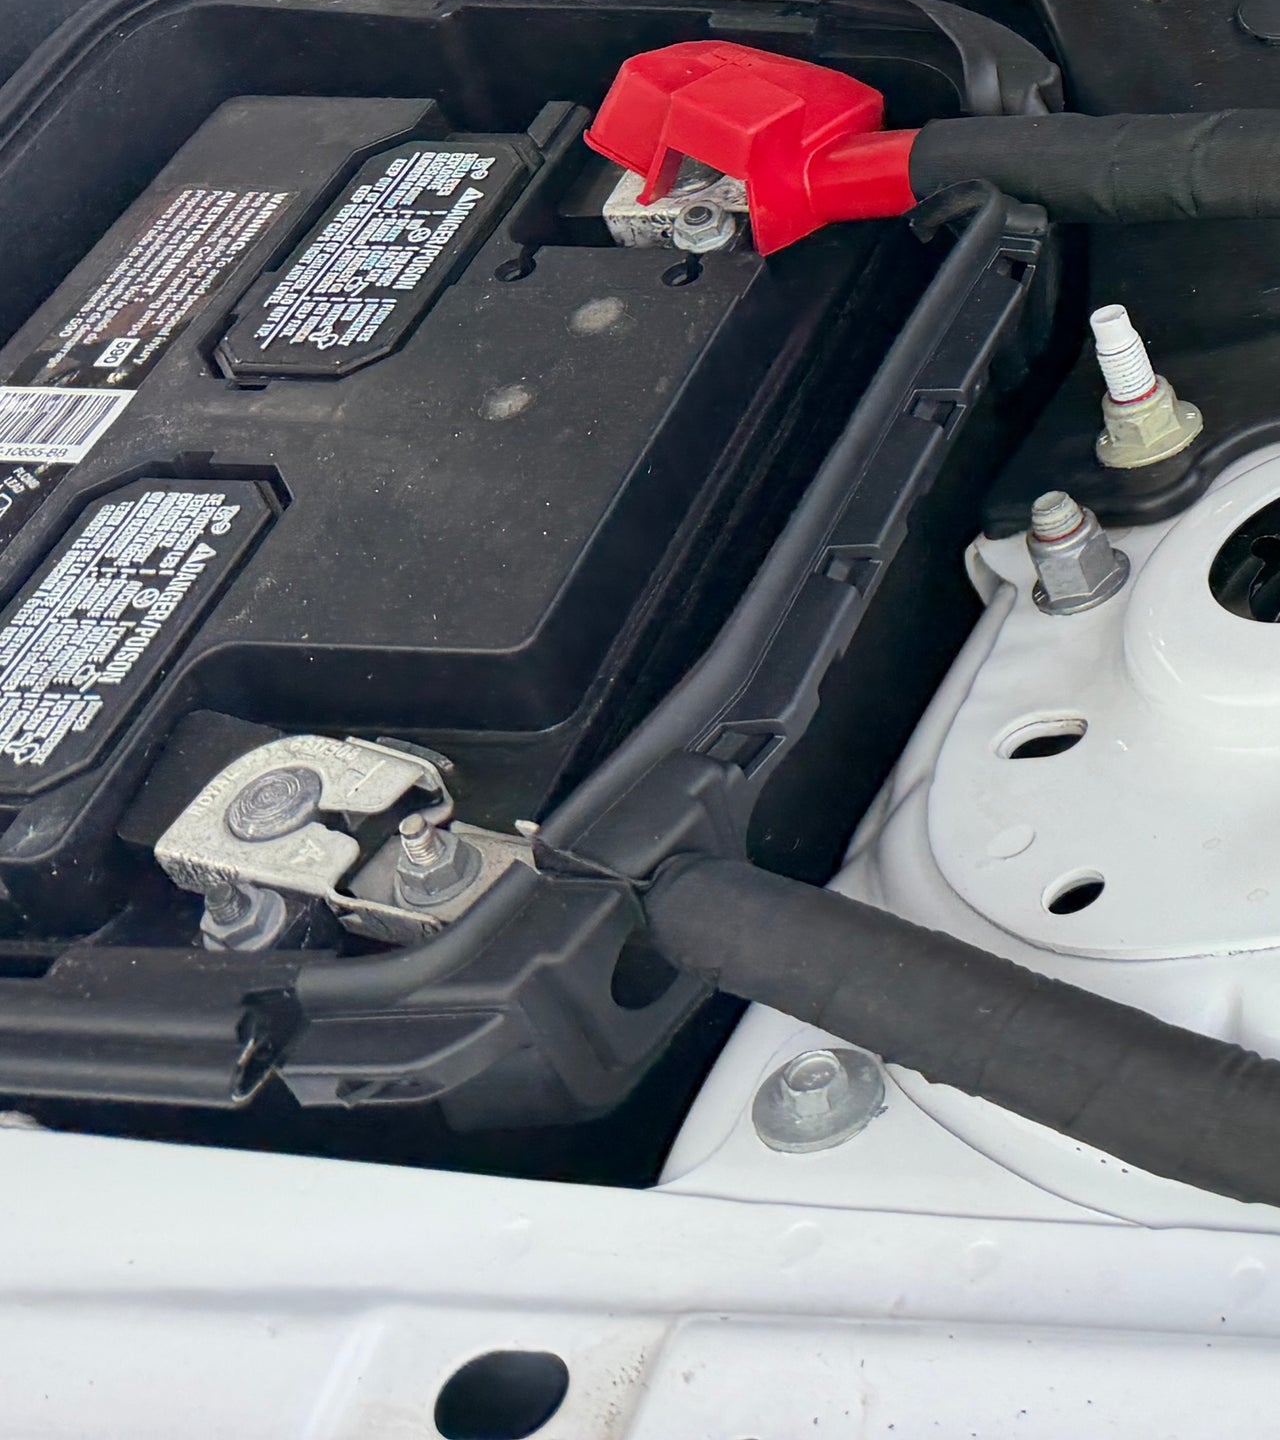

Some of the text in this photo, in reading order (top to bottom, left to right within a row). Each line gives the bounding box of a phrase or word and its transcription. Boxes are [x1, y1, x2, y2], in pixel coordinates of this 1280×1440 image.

[142, 191, 235, 294] AVERTISSEMENT
[393, 202, 474, 288] DANGER/POISON
[185, 245, 211, 267] Cold
[132, 192, 287, 364] WARNING: To avoid personal injury
[193, 263, 212, 276] for
[148, 268, 189, 308] cranking
[171, 277, 200, 301] jump
[151, 302, 176, 324] start
[59, 317, 82, 337] 590
[103, 341, 131, 363] 590
[0, 446, 68, 458] -10655-BB
[99, 563, 203, 682] DANGER/POISON
